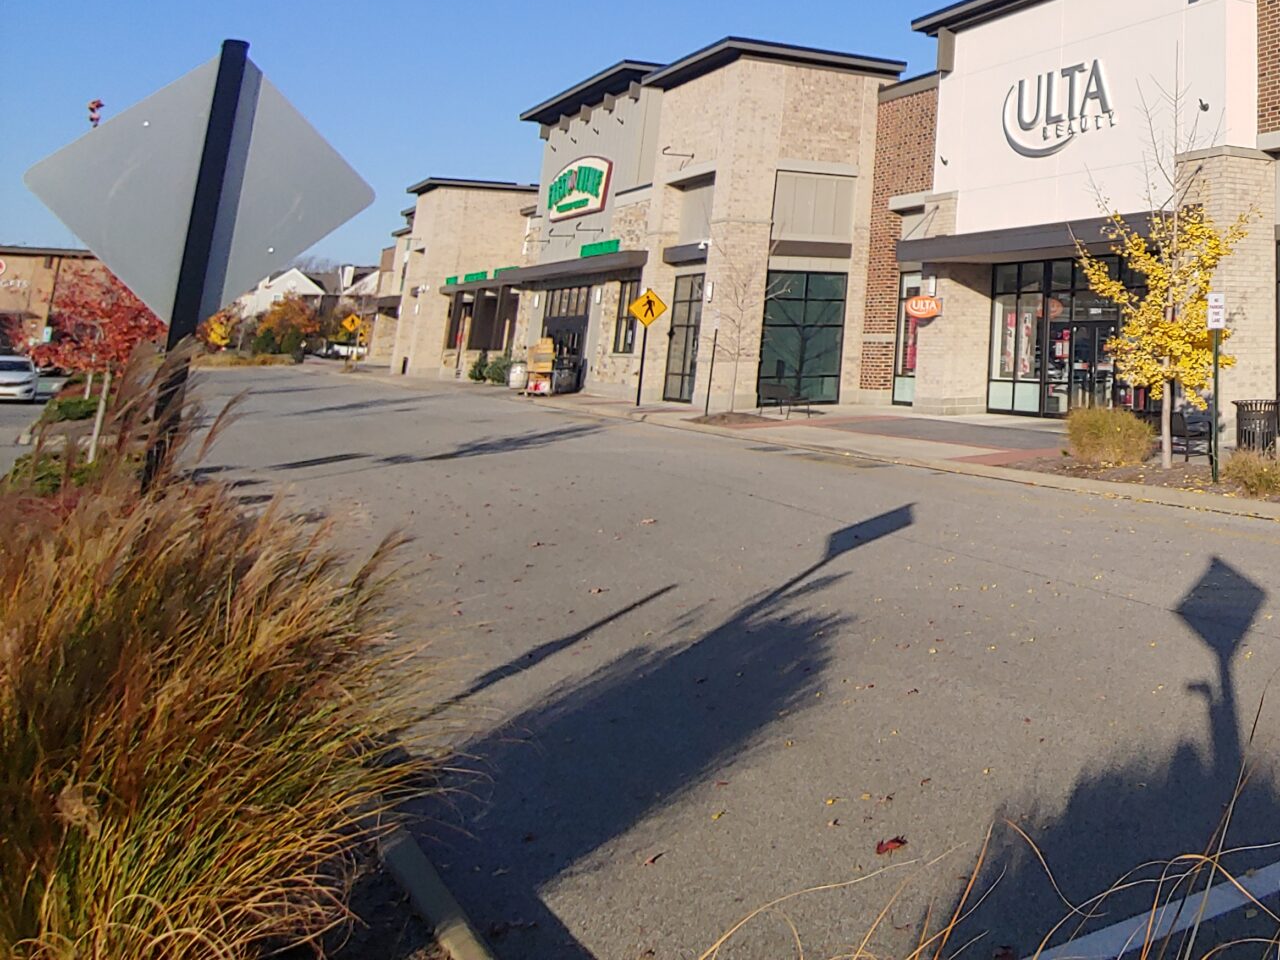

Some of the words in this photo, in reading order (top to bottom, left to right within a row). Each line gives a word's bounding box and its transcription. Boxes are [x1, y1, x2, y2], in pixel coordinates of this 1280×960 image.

[1017, 58, 1113, 132] ULTA
[1042, 110, 1117, 141] BEAUTY
[912, 299, 937, 310] ULTA
